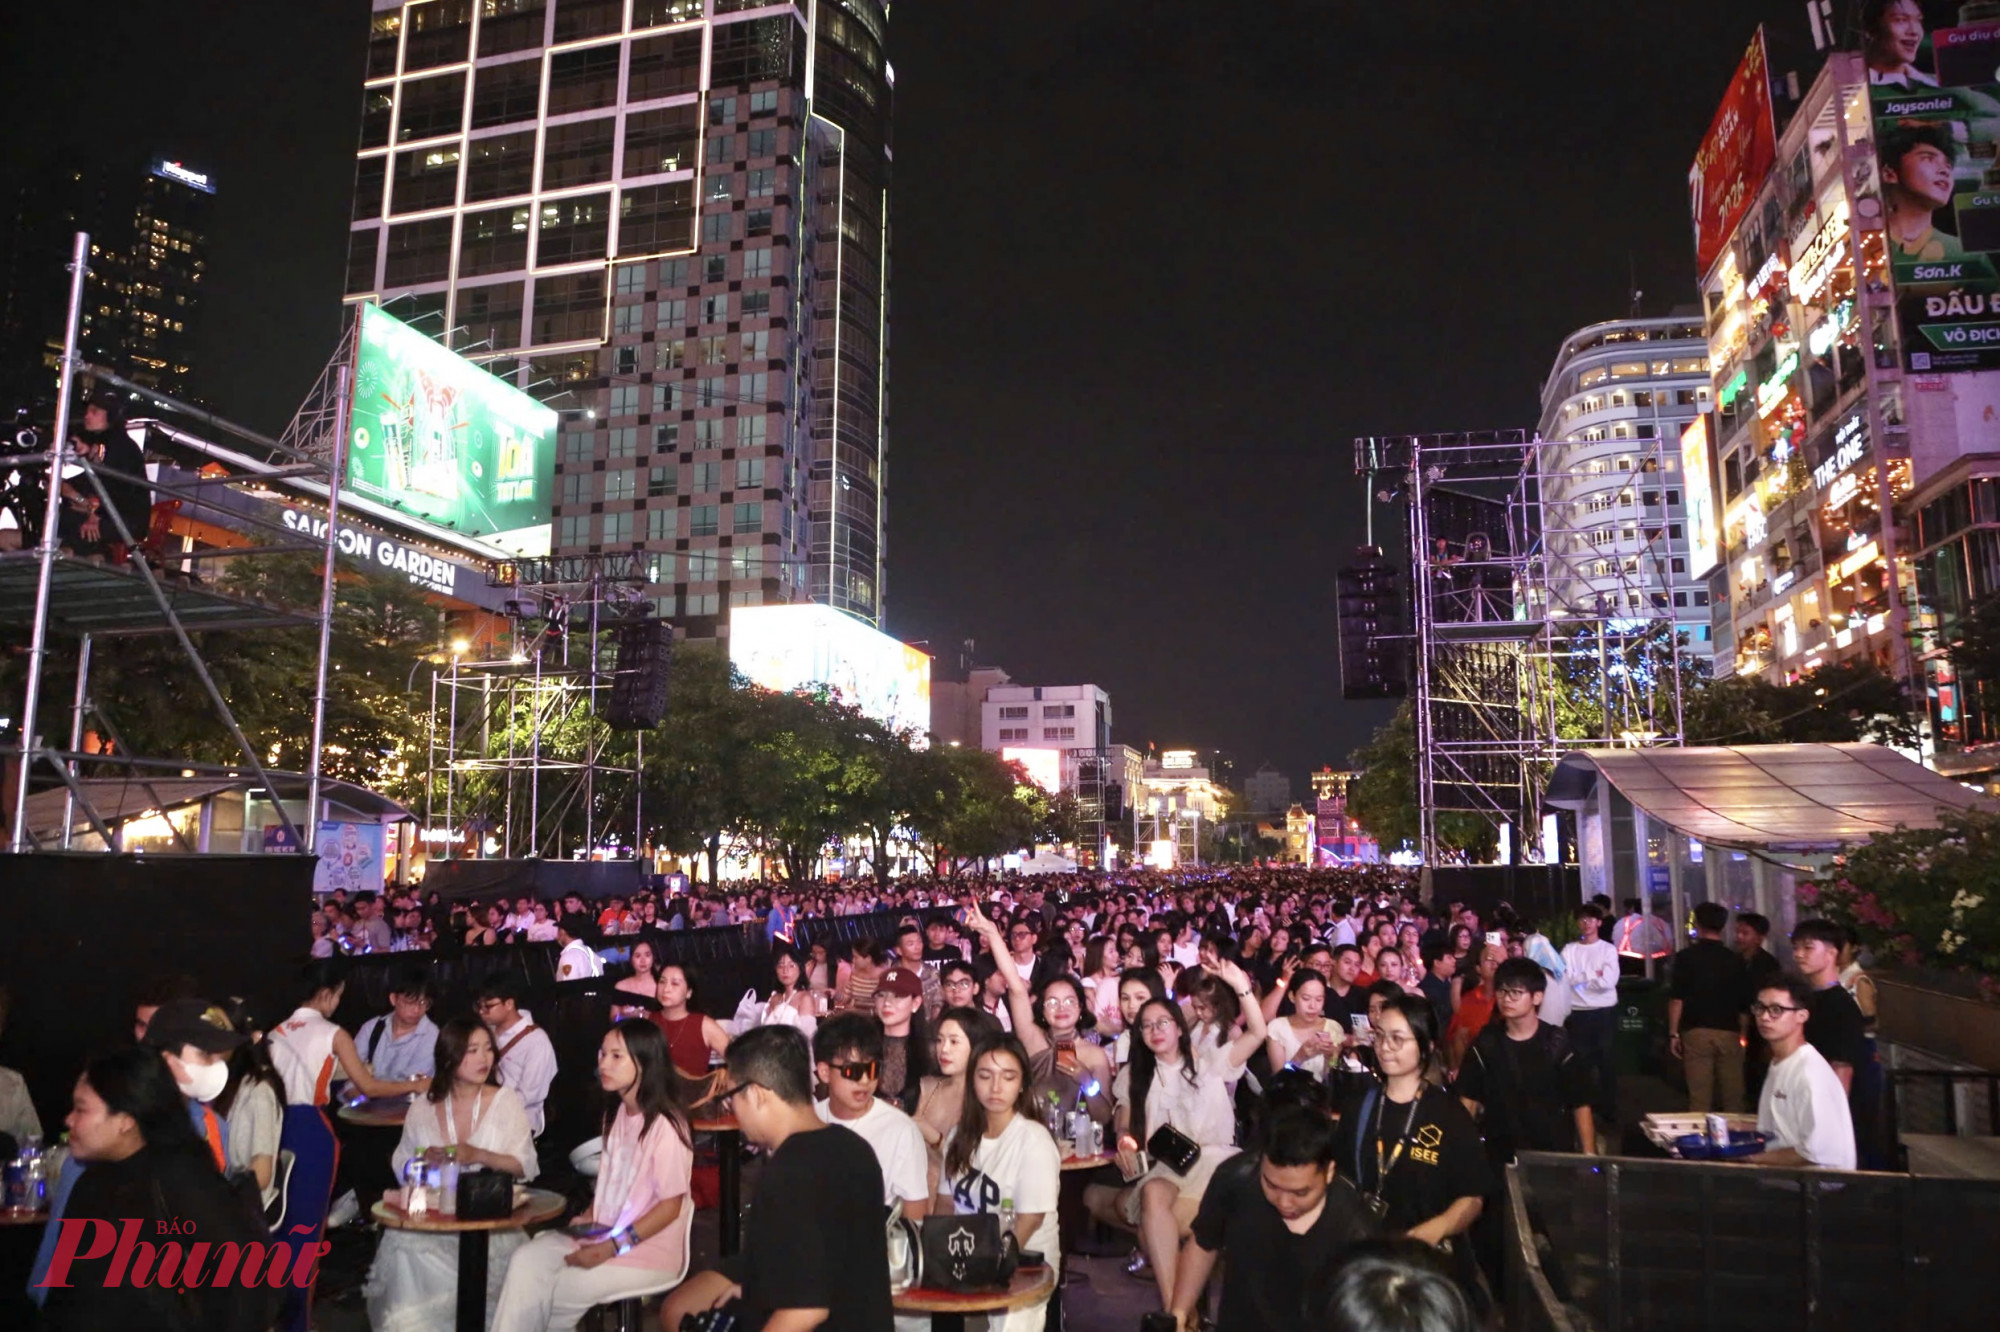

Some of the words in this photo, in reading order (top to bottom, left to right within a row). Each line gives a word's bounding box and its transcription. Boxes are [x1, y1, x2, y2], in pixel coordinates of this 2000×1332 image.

[1719, 171, 1745, 234] 2026
[1925, 288, 1985, 317] ĐẤU
[1943, 327, 1967, 343] VÔ
[1813, 456, 1837, 490] THE
[1837, 432, 1863, 471] ONE
[377, 541, 456, 587] GARDEN
[950, 1167, 1000, 1214] AP
